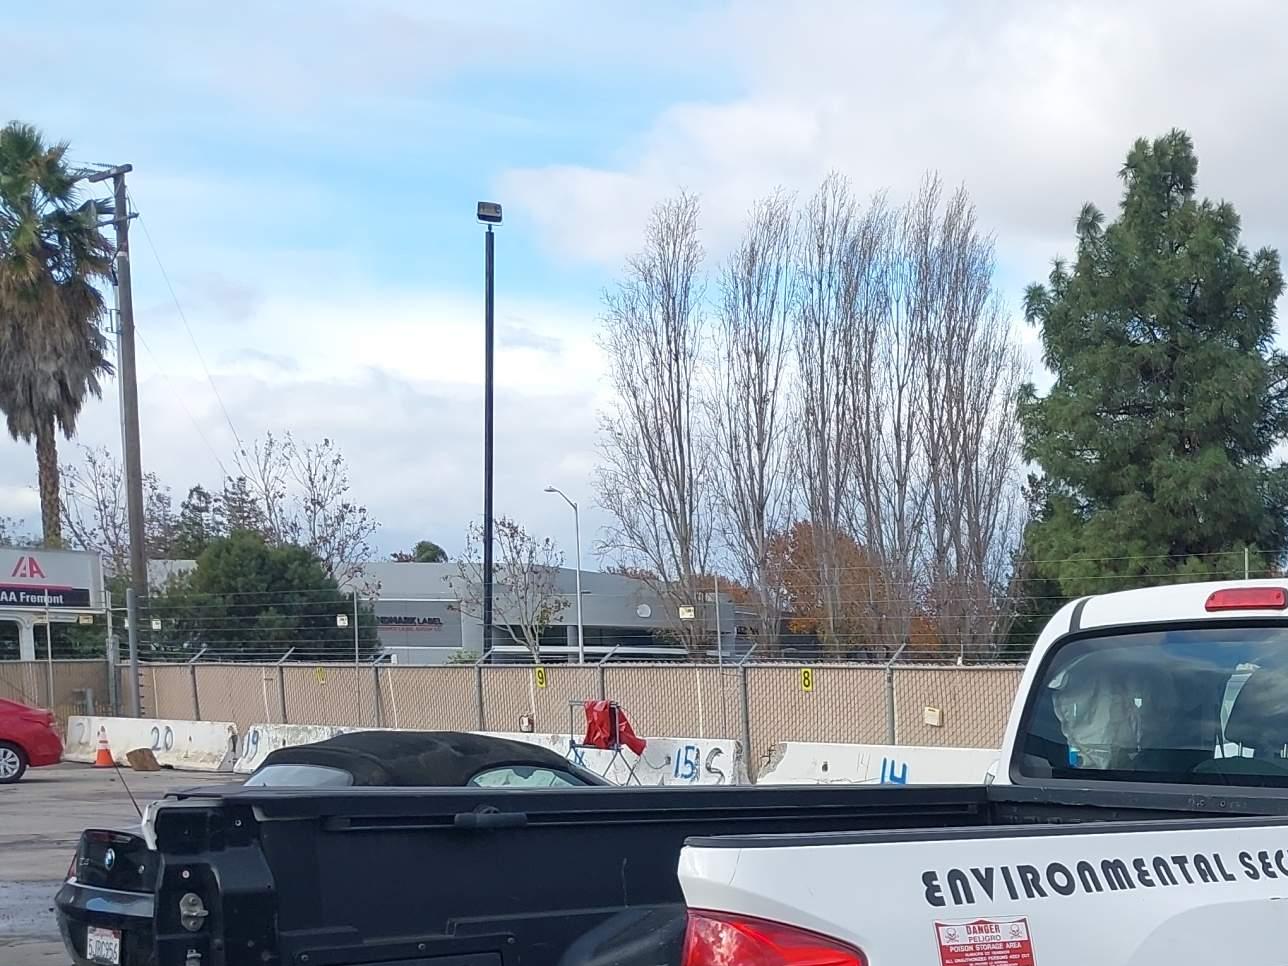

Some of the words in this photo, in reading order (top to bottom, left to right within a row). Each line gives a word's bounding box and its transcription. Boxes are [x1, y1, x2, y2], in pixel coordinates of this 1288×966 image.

[0, 591, 18, 602] AA
[20, 592, 64, 604] Fremont
[538, 670, 545, 685] 9
[803, 671, 810, 688] 8
[151, 726, 174, 751] 20
[243, 730, 260, 762] 19
[674, 746, 696, 779] 15
[880, 757, 908, 784] 14
[922, 853, 1237, 906] ENVIRONMENTAL
[966, 925, 1001, 935] DANGER
[968, 935, 1001, 943] PELIGRO
[976, 943, 1004, 951] STORAGE
[1006, 941, 1022, 949] AREA
